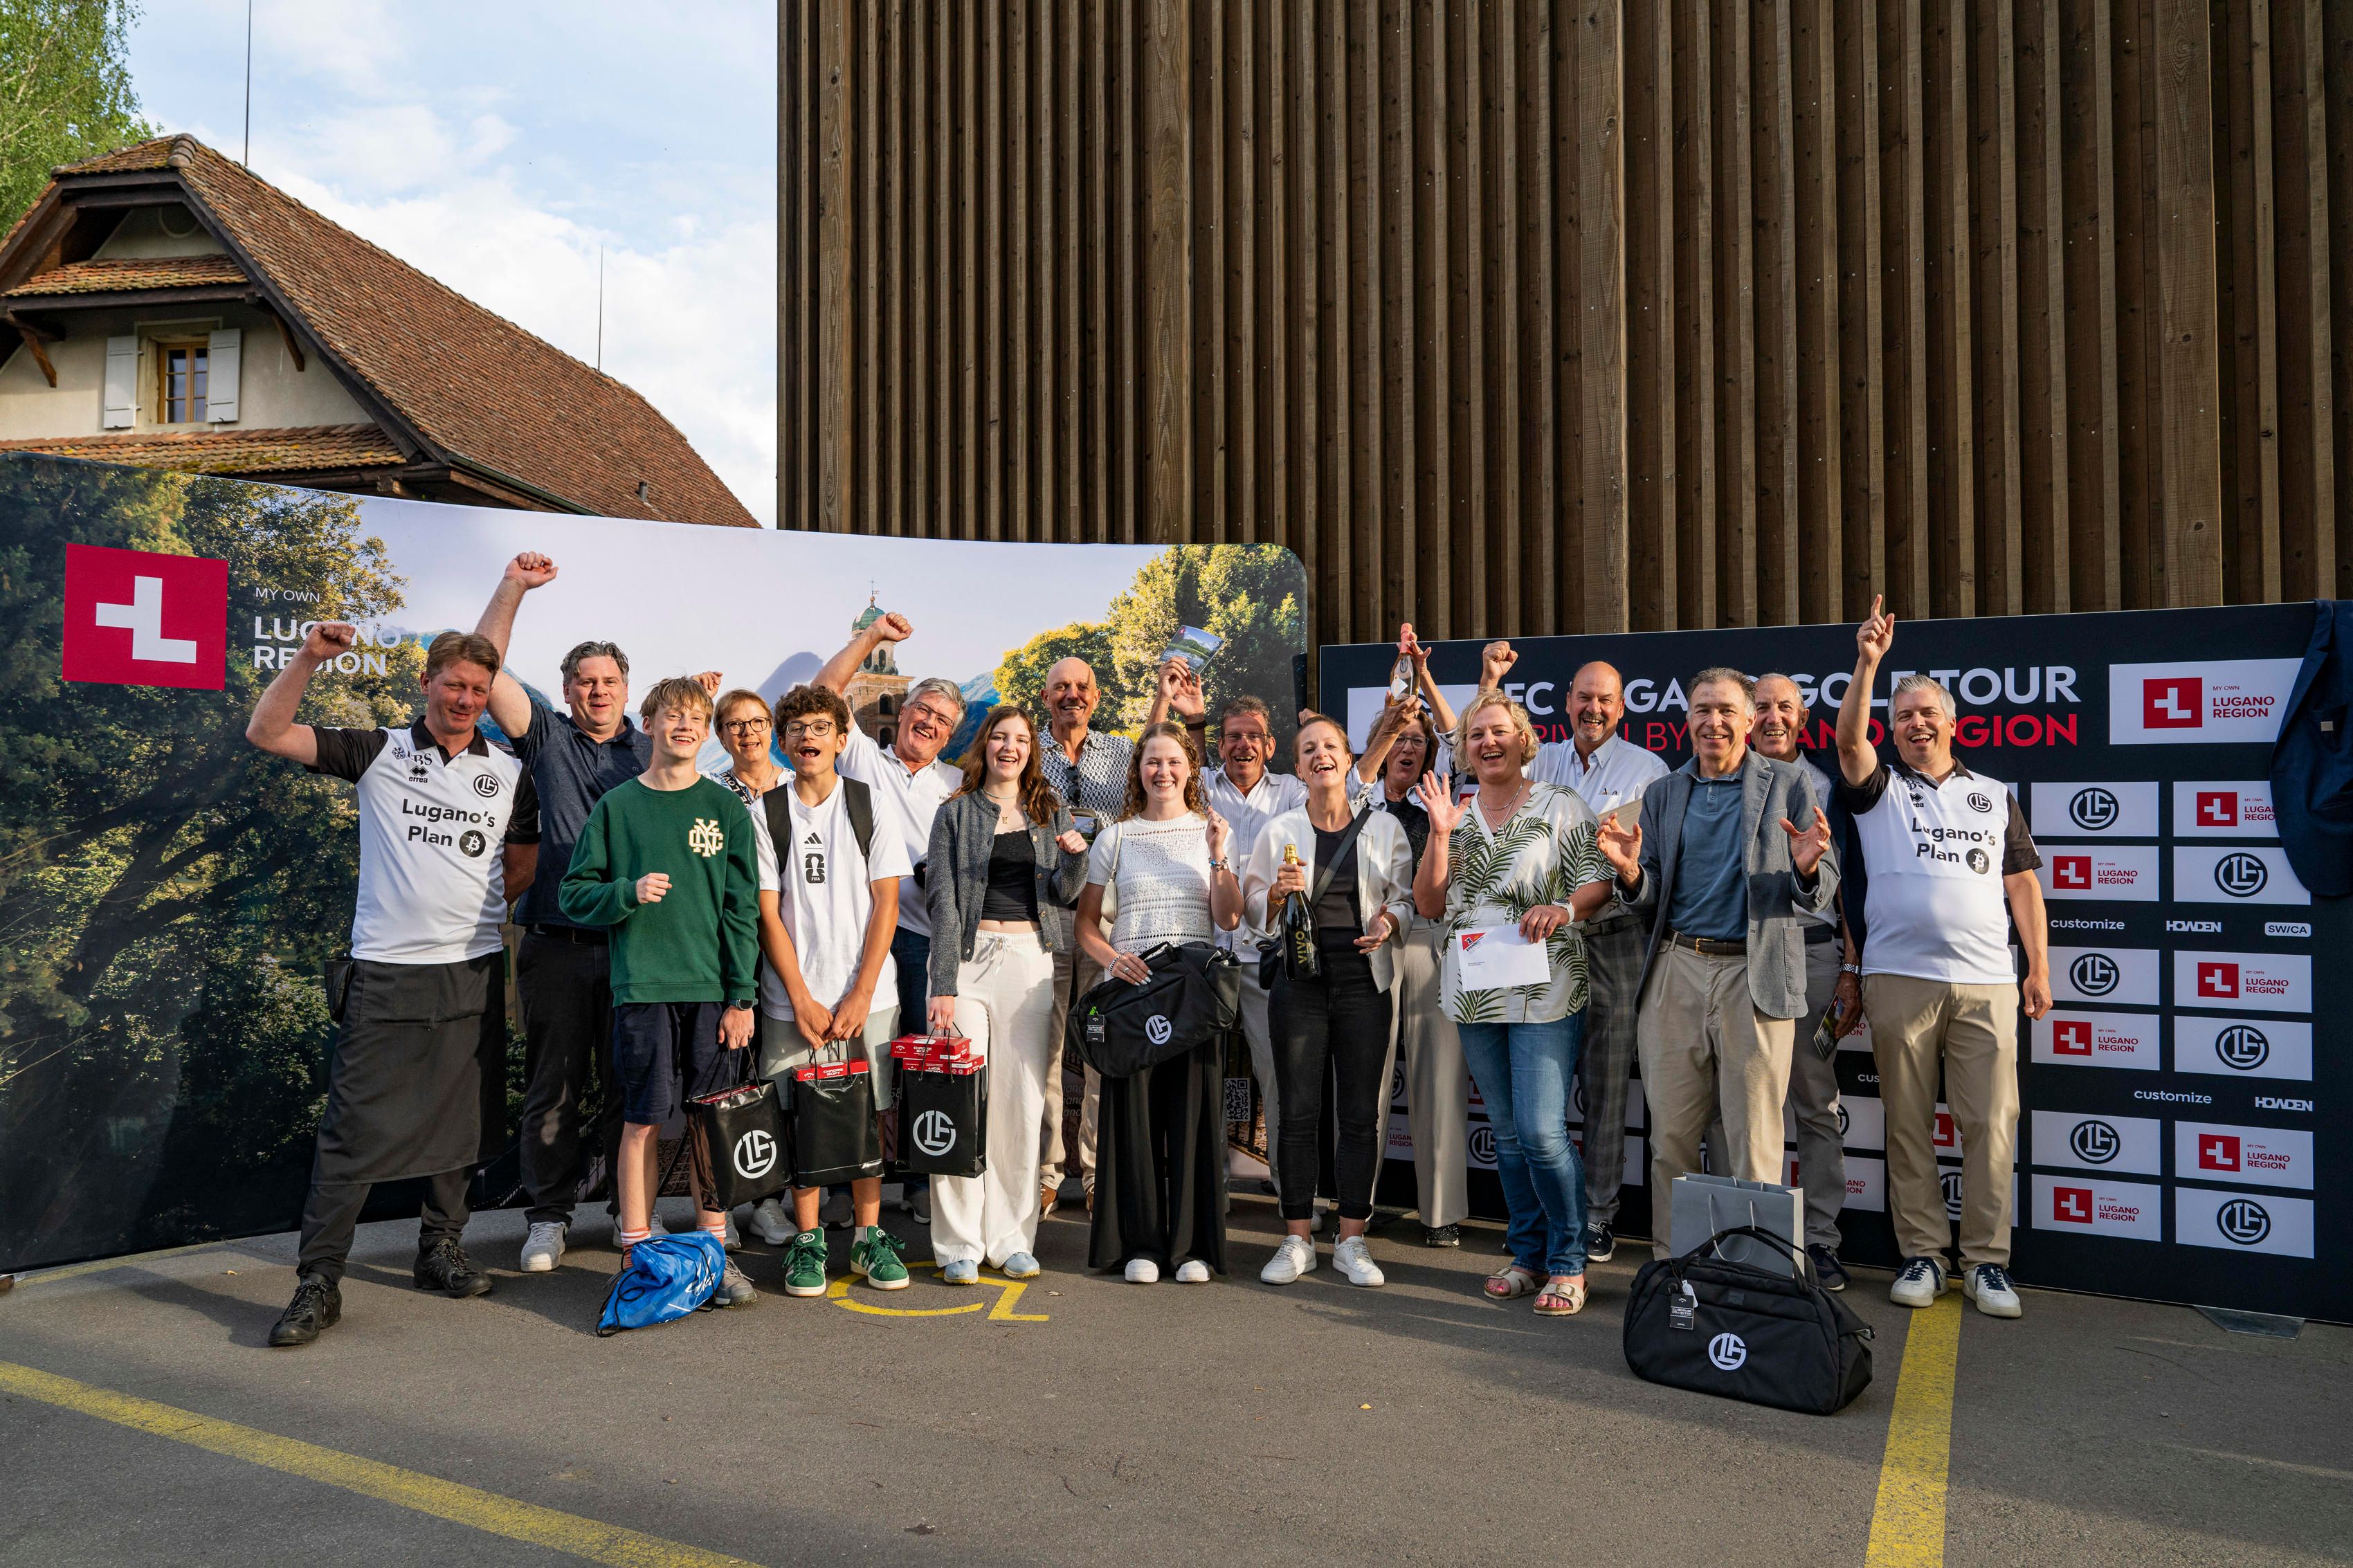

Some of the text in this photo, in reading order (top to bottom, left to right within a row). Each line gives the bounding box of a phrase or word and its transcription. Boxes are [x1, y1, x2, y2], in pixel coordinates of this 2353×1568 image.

[255, 587, 320, 603] MY OWN
[255, 616, 401, 648] LUNO
[254, 645, 386, 676] REION
[1929, 666, 2082, 706] TOUR
[2213, 696, 2275, 706] LUGANO
[2213, 708, 2269, 718] REGION
[1646, 722, 1688, 752] BY
[1950, 714, 2077, 748] GION
[402, 799, 496, 828] Lugano's
[408, 826, 453, 847] Plan
[1916, 843, 1960, 863] Plan
[2051, 919, 2125, 930] customize
[2166, 920, 2222, 933] HOWDEN
[1295, 931, 1307, 965] VIVO
[2246, 978, 2289, 987] LUGANO
[2246, 986, 2284, 994] REGION
[2098, 1036, 2138, 1045] LUGANO
[2098, 1044, 2134, 1052] REGION
[2134, 1091, 2212, 1104] customize
[2255, 1096, 2313, 1112] HOWDEN
[2247, 1151, 2290, 1163] LUGANO
[2247, 1160, 2287, 1170] REGION
[2099, 1204, 2140, 1214] LUGANO
[2099, 1212, 2136, 1222] REGION
